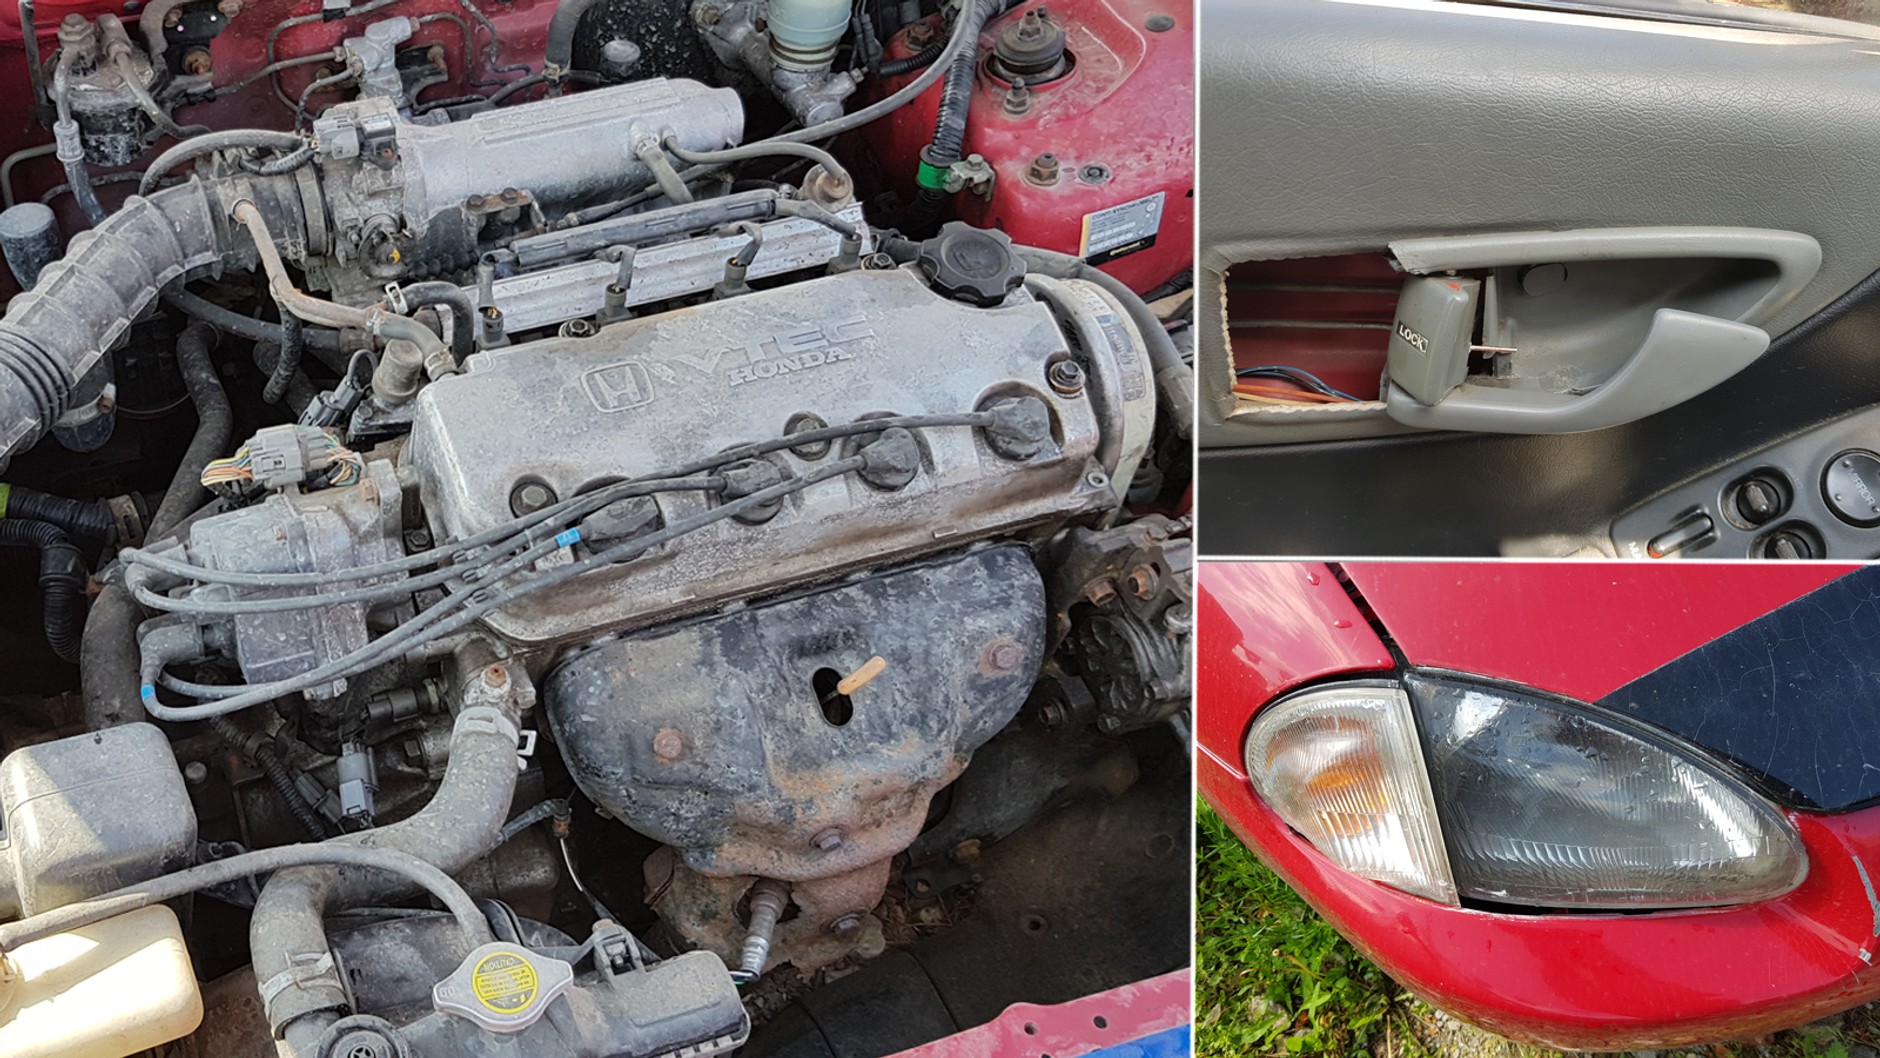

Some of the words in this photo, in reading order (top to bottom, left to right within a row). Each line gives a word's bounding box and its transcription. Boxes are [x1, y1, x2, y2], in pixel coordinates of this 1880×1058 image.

[671, 314, 875, 375] VTEC
[1399, 324, 1425, 353] LOCK
[727, 346, 853, 387] HONDA
[1847, 467, 1876, 506] MIRROR
